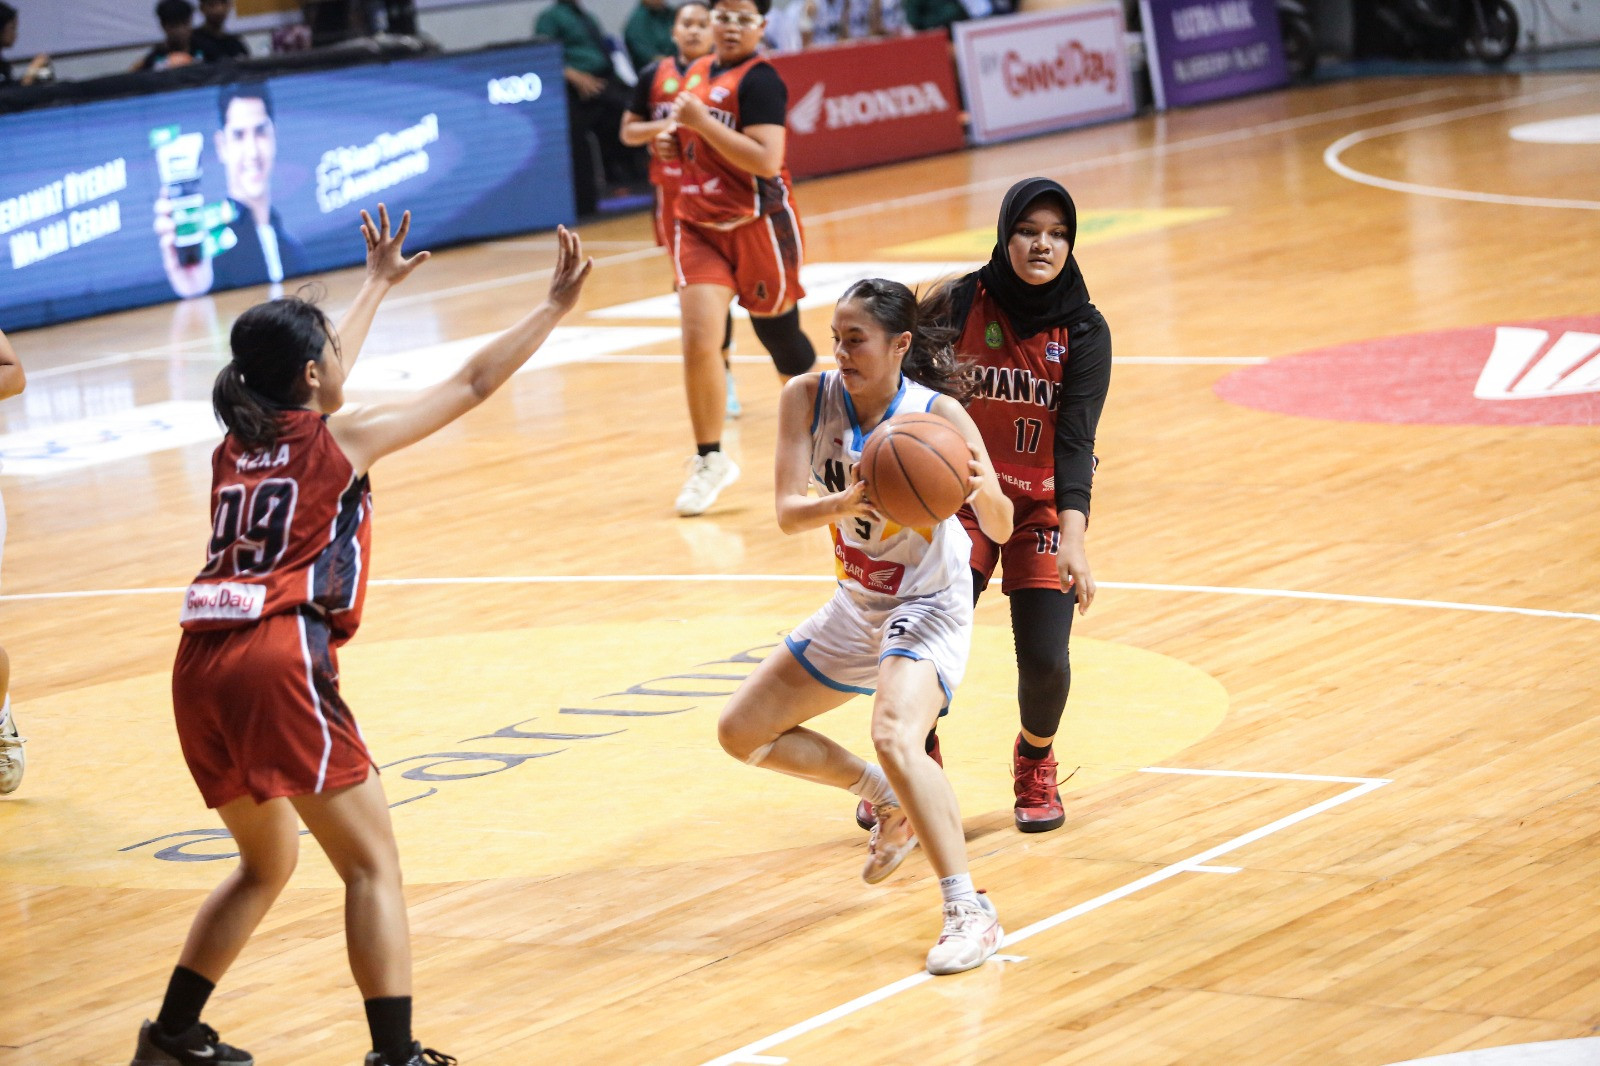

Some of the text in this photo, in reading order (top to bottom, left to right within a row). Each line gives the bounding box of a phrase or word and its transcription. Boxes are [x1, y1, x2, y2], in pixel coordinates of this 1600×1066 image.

[825, 81, 949, 130] HONDA
[1014, 416, 1043, 454] 17
[887, 617, 909, 639] 5
